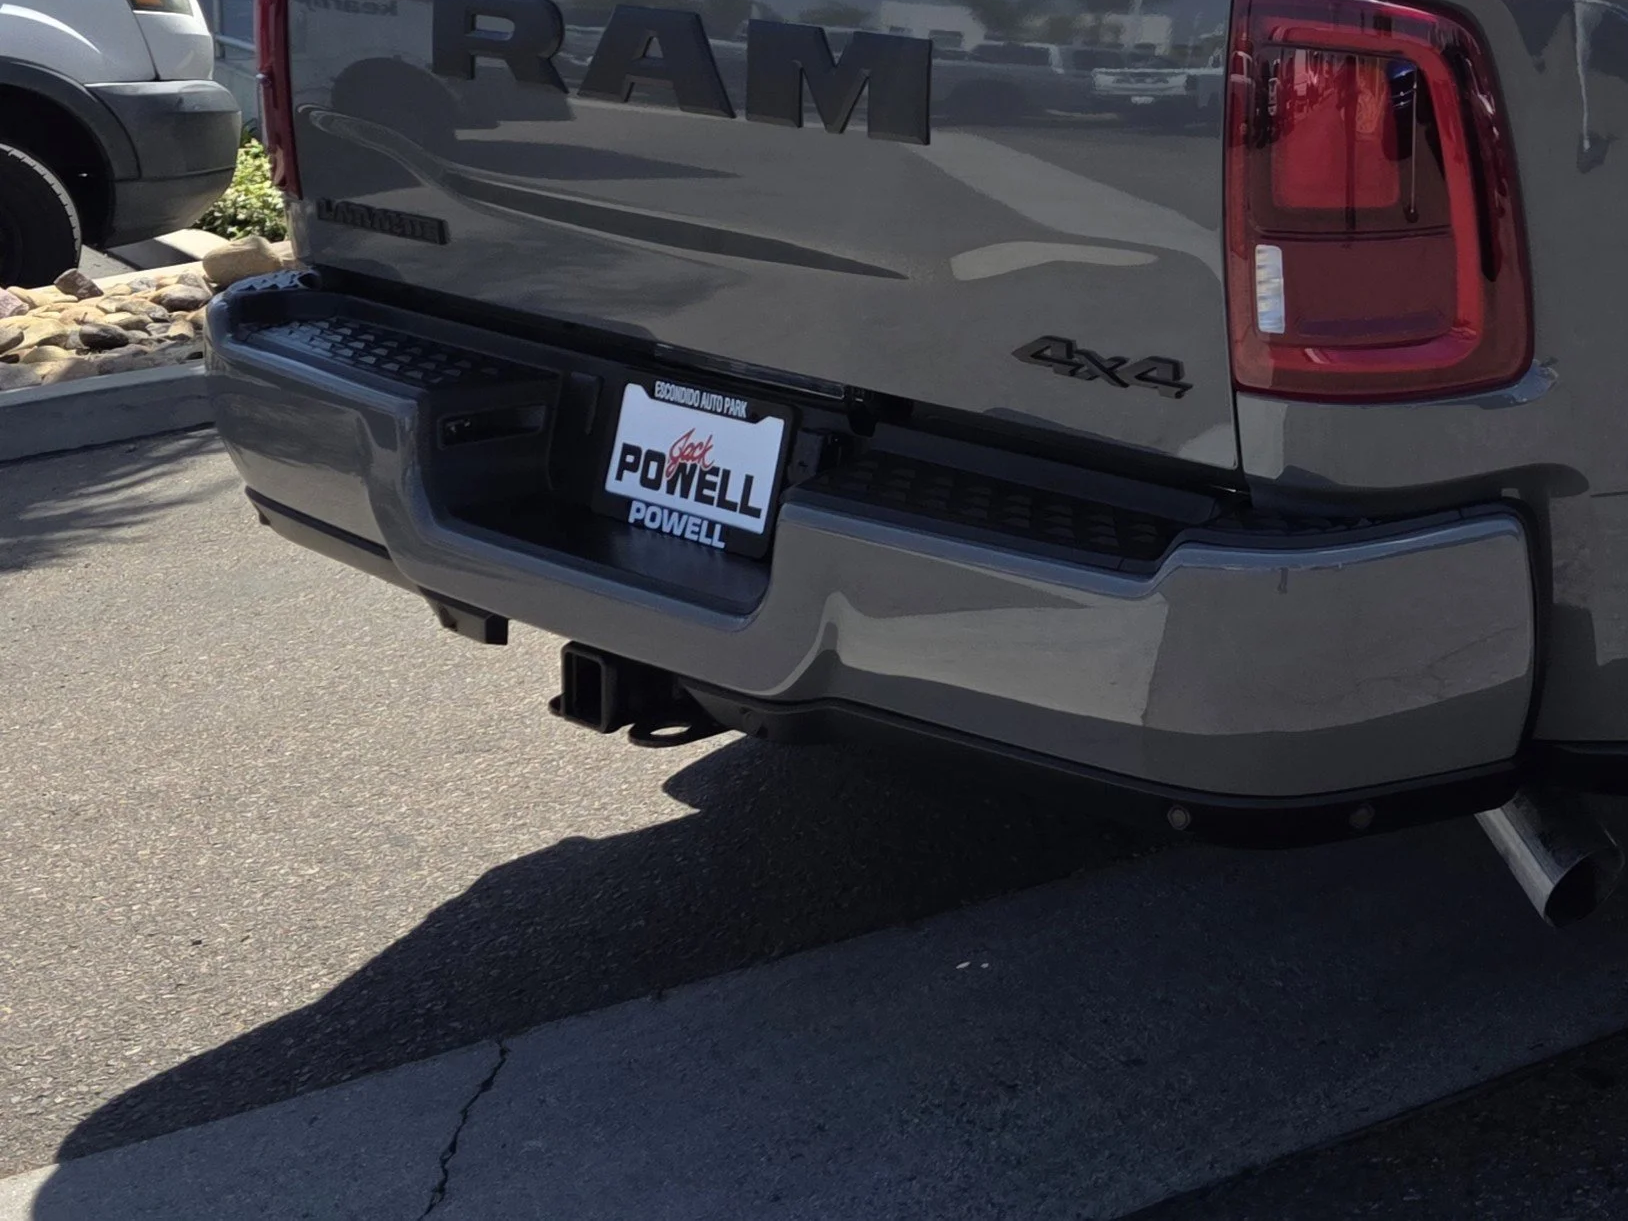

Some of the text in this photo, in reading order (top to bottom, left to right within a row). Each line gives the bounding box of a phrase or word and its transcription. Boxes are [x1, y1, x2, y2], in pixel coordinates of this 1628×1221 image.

[654, 380, 748, 419] ESCONDIDO AUTO PARK
[665, 428, 715, 478] Jack
[615, 442, 762, 519] POWELL
[628, 500, 726, 549] POWELL
